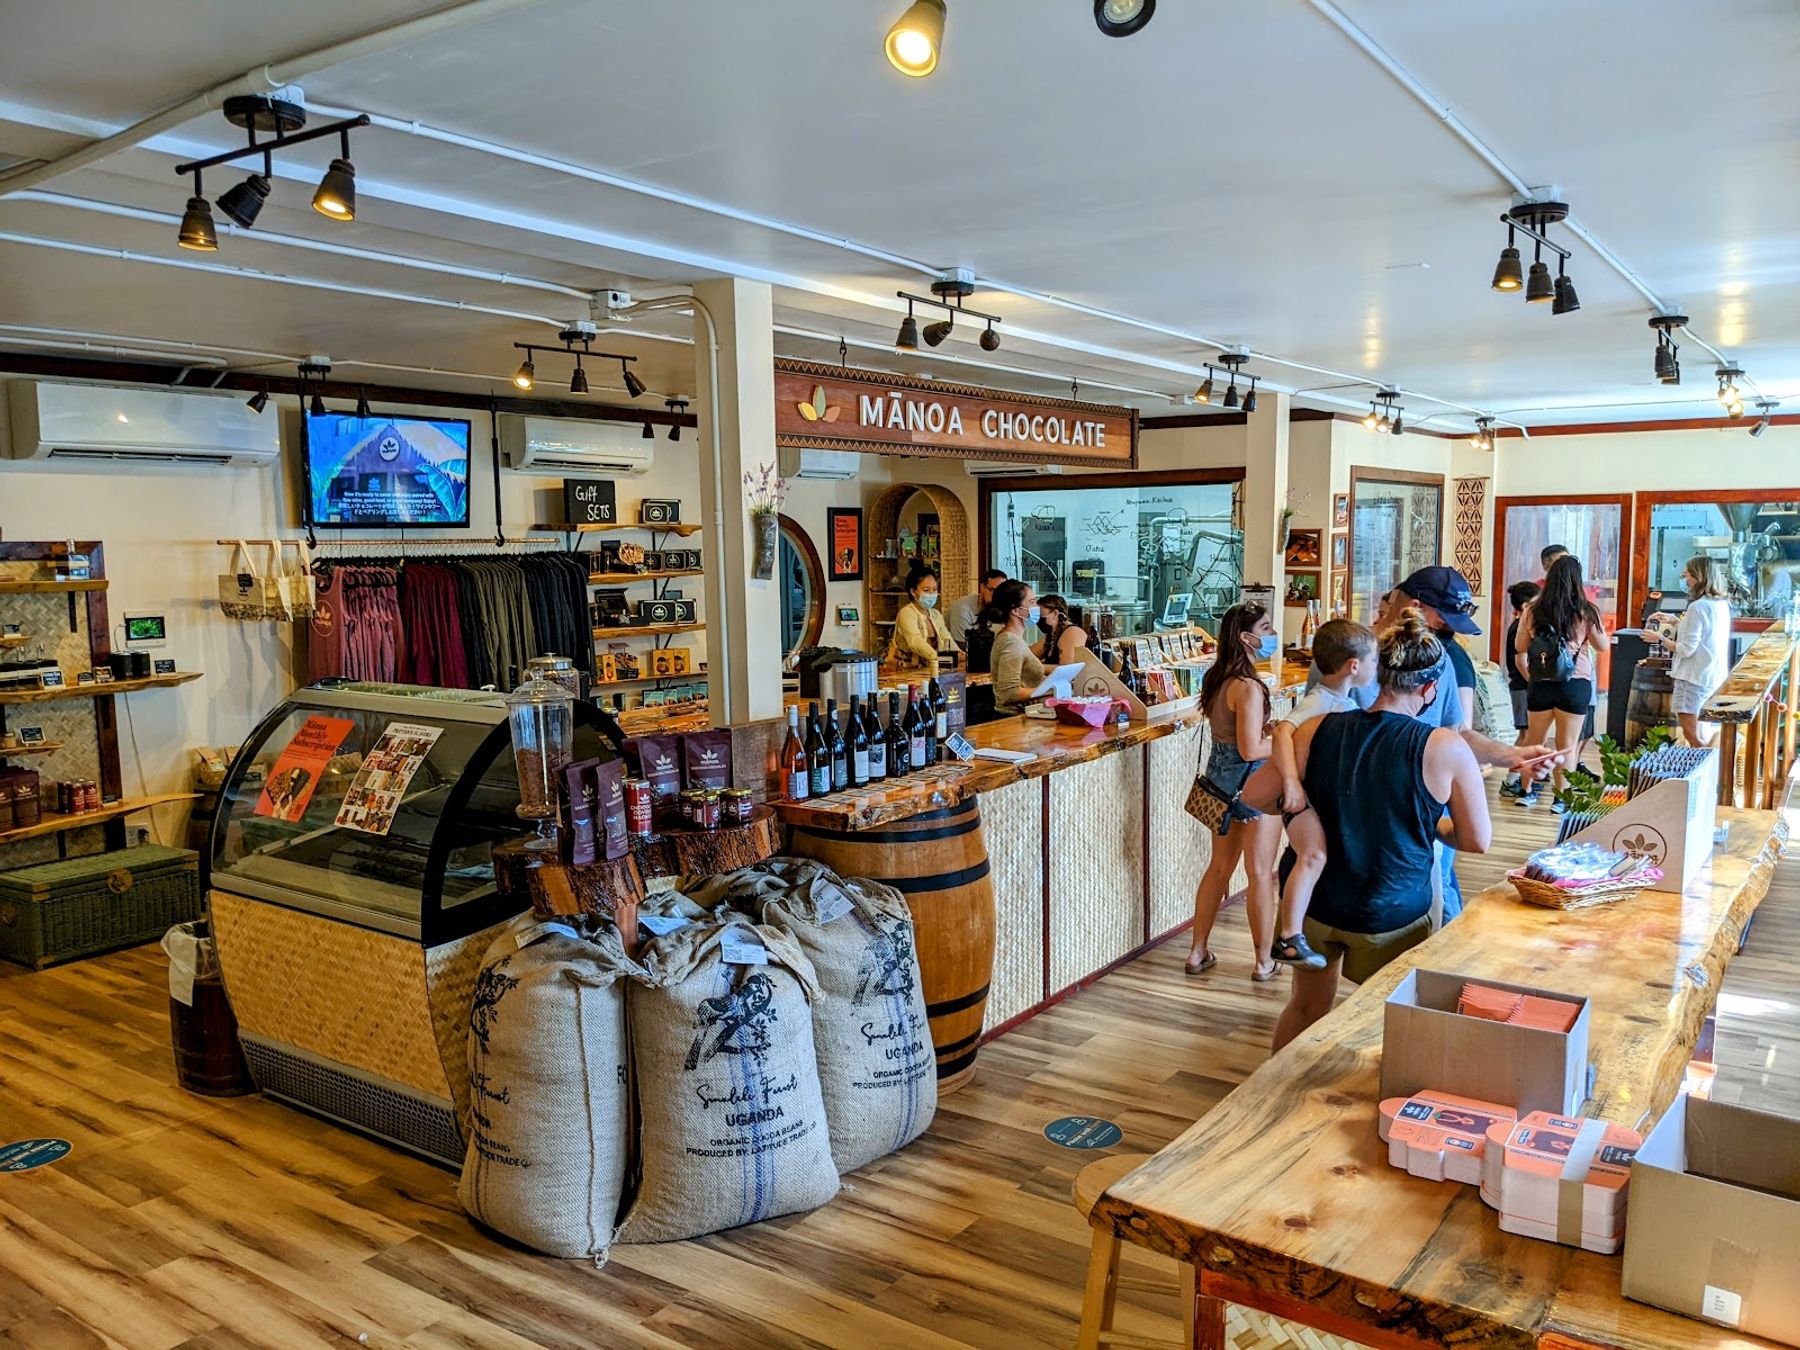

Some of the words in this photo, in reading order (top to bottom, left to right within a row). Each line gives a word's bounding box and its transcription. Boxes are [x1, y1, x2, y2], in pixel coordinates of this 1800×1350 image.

[859, 391, 964, 435] MĀNOA
[981, 409, 1106, 447] CHOCOLATE
[575, 485, 598, 502] Gift
[587, 504, 610, 521] SETS
[885, 1040, 924, 1060] UGANDA
[873, 1068, 903, 1079] ORGANIC
[852, 1079, 892, 1090] PRODUCED
[725, 1105, 785, 1128] UGANDA
[709, 1137, 750, 1147] ORGANIC
[782, 1119, 804, 1135] BEANS
[496, 1153, 520, 1167] TRADE
[686, 1147, 734, 1158] PRODUCED
